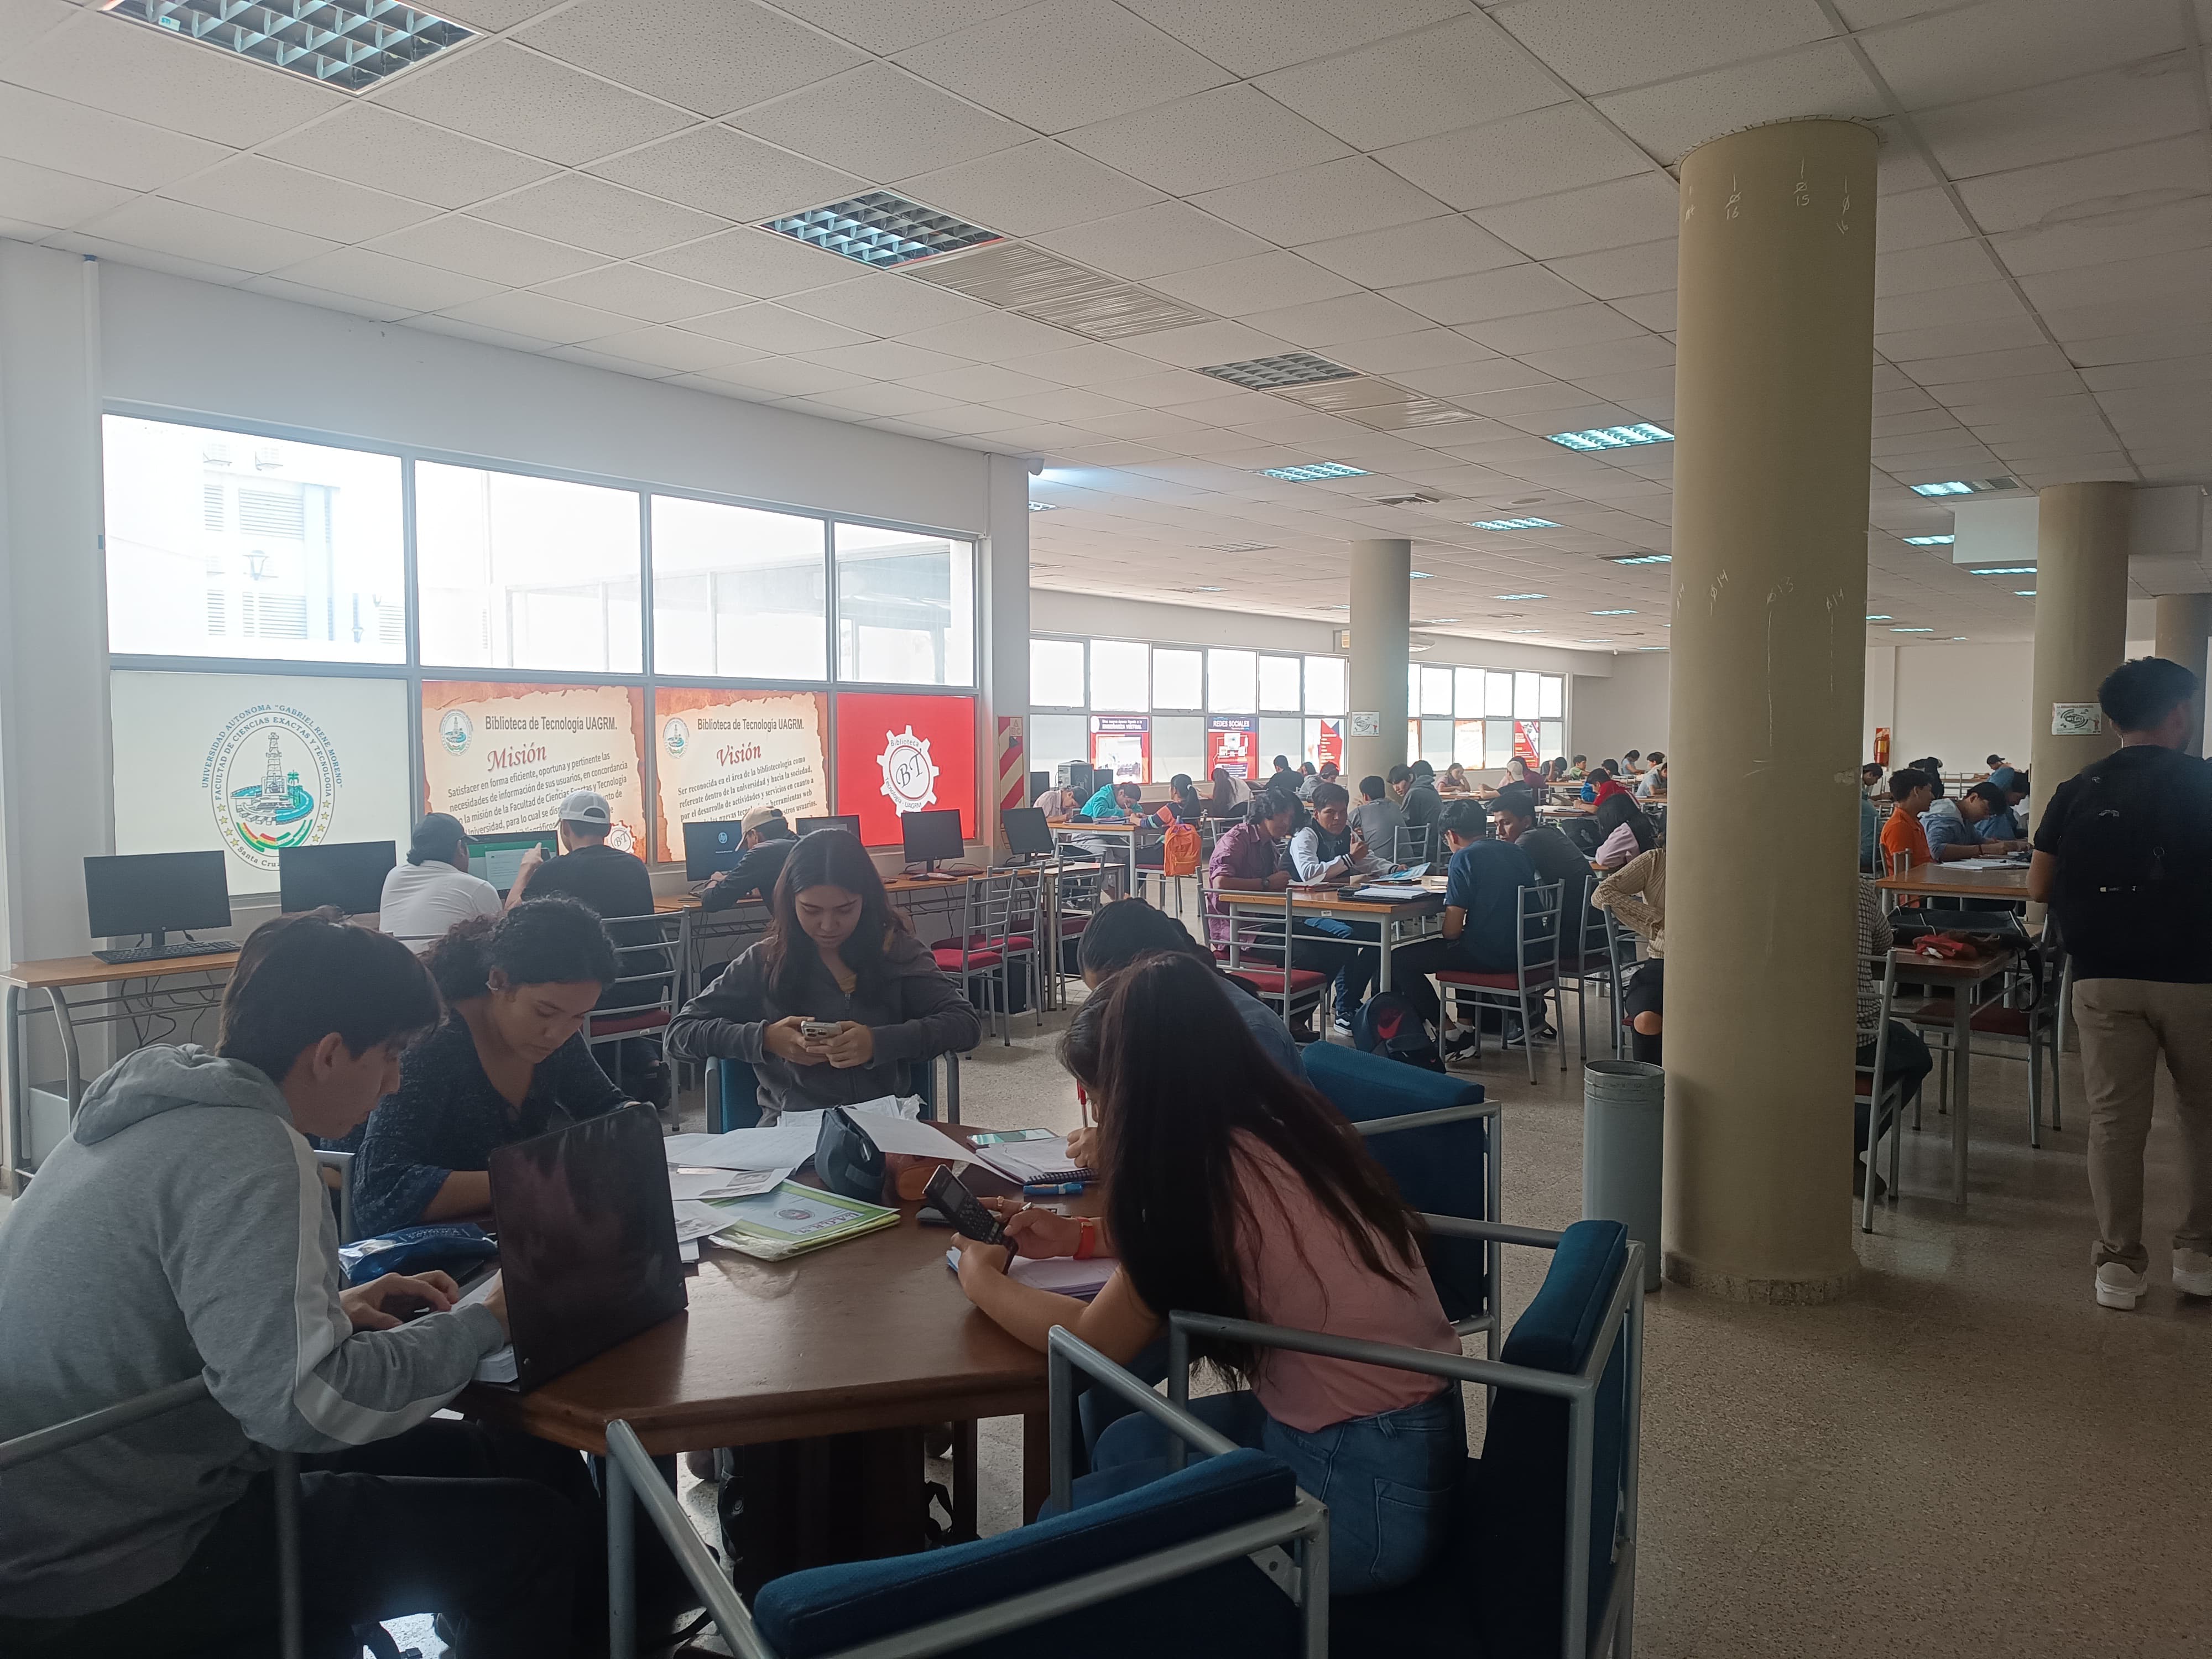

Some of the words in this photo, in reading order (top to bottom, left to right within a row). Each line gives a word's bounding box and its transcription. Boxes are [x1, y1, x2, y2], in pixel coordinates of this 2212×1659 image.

[486, 716, 526, 730] Biblioteca
[529, 716, 539, 730] de
[541, 716, 584, 733] Tecnología
[586, 717, 618, 730] UAGRM.
[697, 718, 731, 730] Biblioteca
[733, 718, 741, 730] de
[742, 718, 777, 733] Tecnología
[778, 718, 805, 730] UAGRM.
[202, 731, 226, 788] UNIVERSIDAD
[226, 705, 272, 731] AUTONOMA
[314, 727, 331, 747] RENE
[487, 742, 547, 772] Misión
[716, 742, 761, 767] Visión
[890, 738, 919, 747] Biblioteca
[215, 756, 227, 800] FACULTAD
[224, 742, 234, 754] DE
[232, 717, 270, 742] CIENCIAS
[273, 717, 310, 739] EXACTAS
[314, 745, 332, 797] TECNOLOGIA
[896, 748, 923, 789] BT
[448, 784, 479, 798] Satisfacer
[490, 777, 509, 788] forma
[510, 769, 538, 783] eficiente,
[539, 764, 566, 777] oportuna
[567, 762, 571, 771] y
[571, 754, 601, 770] pertinente
[602, 752, 611, 761] las
[450, 796, 489, 812] necesidades
[489, 793, 498, 802] de
[499, 784, 536, 800] información
[536, 781, 544, 791] de
[545, 780, 555, 789] sus
[556, 773, 582, 786] usuarios,
[591, 761, 628, 777] concordancia
[678, 787, 687, 796] Ser
[688, 779, 717, 793] reconocida
[726, 775, 731, 783] el
[732, 773, 743, 781] área
[744, 770, 750, 778] de
[793, 757, 806, 765] como
[464, 814, 471, 823] la
[472, 809, 493, 822] misión
[494, 806, 502, 816] de
[503, 805, 509, 813] la
[510, 797, 536, 812] Facultad
[536, 795, 545, 804] de
[593, 784, 597, 792] y
[615, 789, 622, 799] de
[679, 796, 703, 808] referente
[705, 791, 722, 801] dentro
[723, 788, 729, 796] de
[737, 778, 766, 792] universidad
[766, 778, 770, 786] y
[771, 773, 784, 783] hacia
[680, 812, 690, 823] por
[691, 809, 696, 817] el
[697, 802, 724, 816] desarrollo
[725, 800, 731, 808] de
[732, 792, 760, 806] actividades
[761, 791, 764, 800] y
[765, 785, 786, 797] servicios
[794, 778, 810, 788] cuanto
[770, 792, 802, 806] herramientas
[802, 789, 812, 797] web
[796, 800, 817, 811] usuarios.
[506, 818, 520, 829] para
[521, 814, 527, 823] lo
[528, 810, 541, 821] cual
[542, 808, 549, 818] se
[238, 846, 258, 864] Santa
